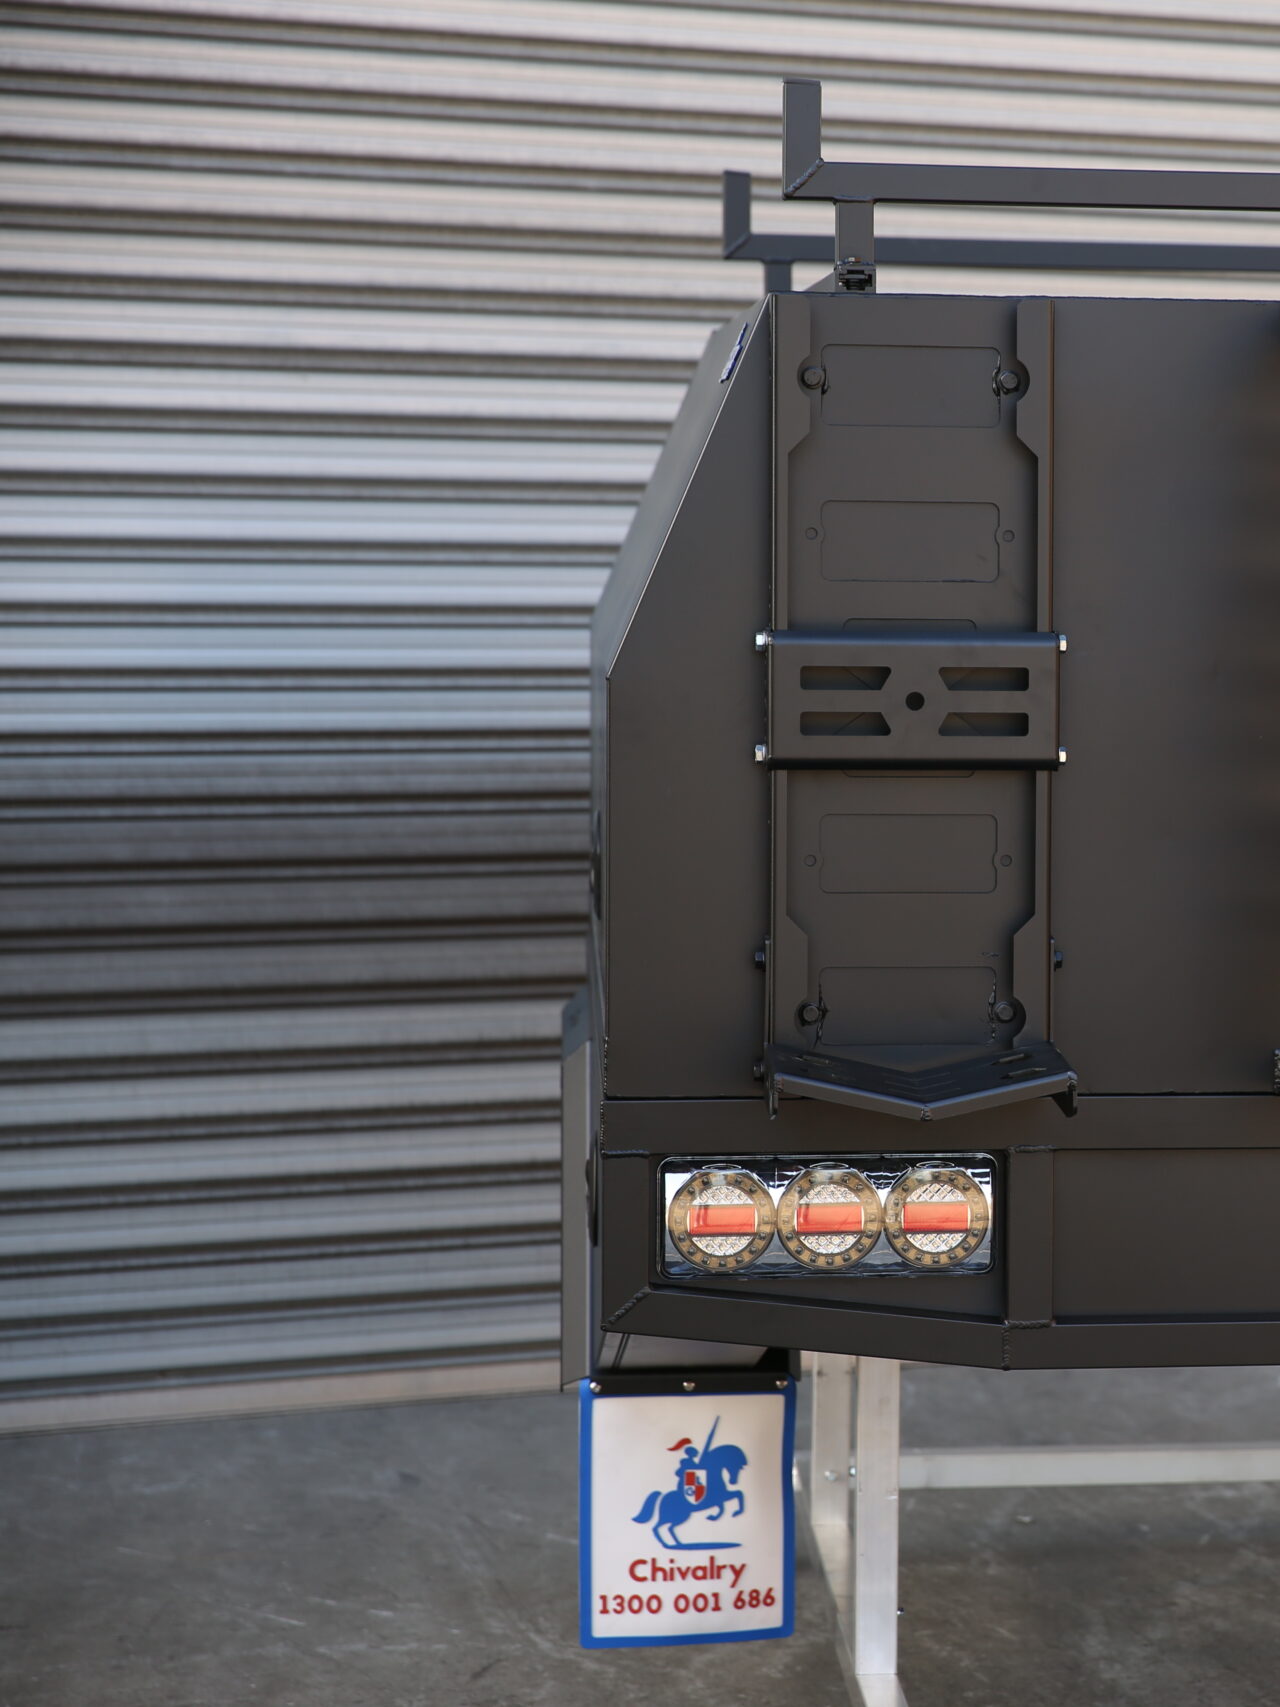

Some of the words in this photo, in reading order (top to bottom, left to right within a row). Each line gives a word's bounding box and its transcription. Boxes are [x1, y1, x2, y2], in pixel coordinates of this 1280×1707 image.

[628, 1555, 747, 1588] Chivalry
[599, 1594, 662, 1614] 1300
[673, 1592, 722, 1614] 001
[732, 1587, 776, 1610] 686
